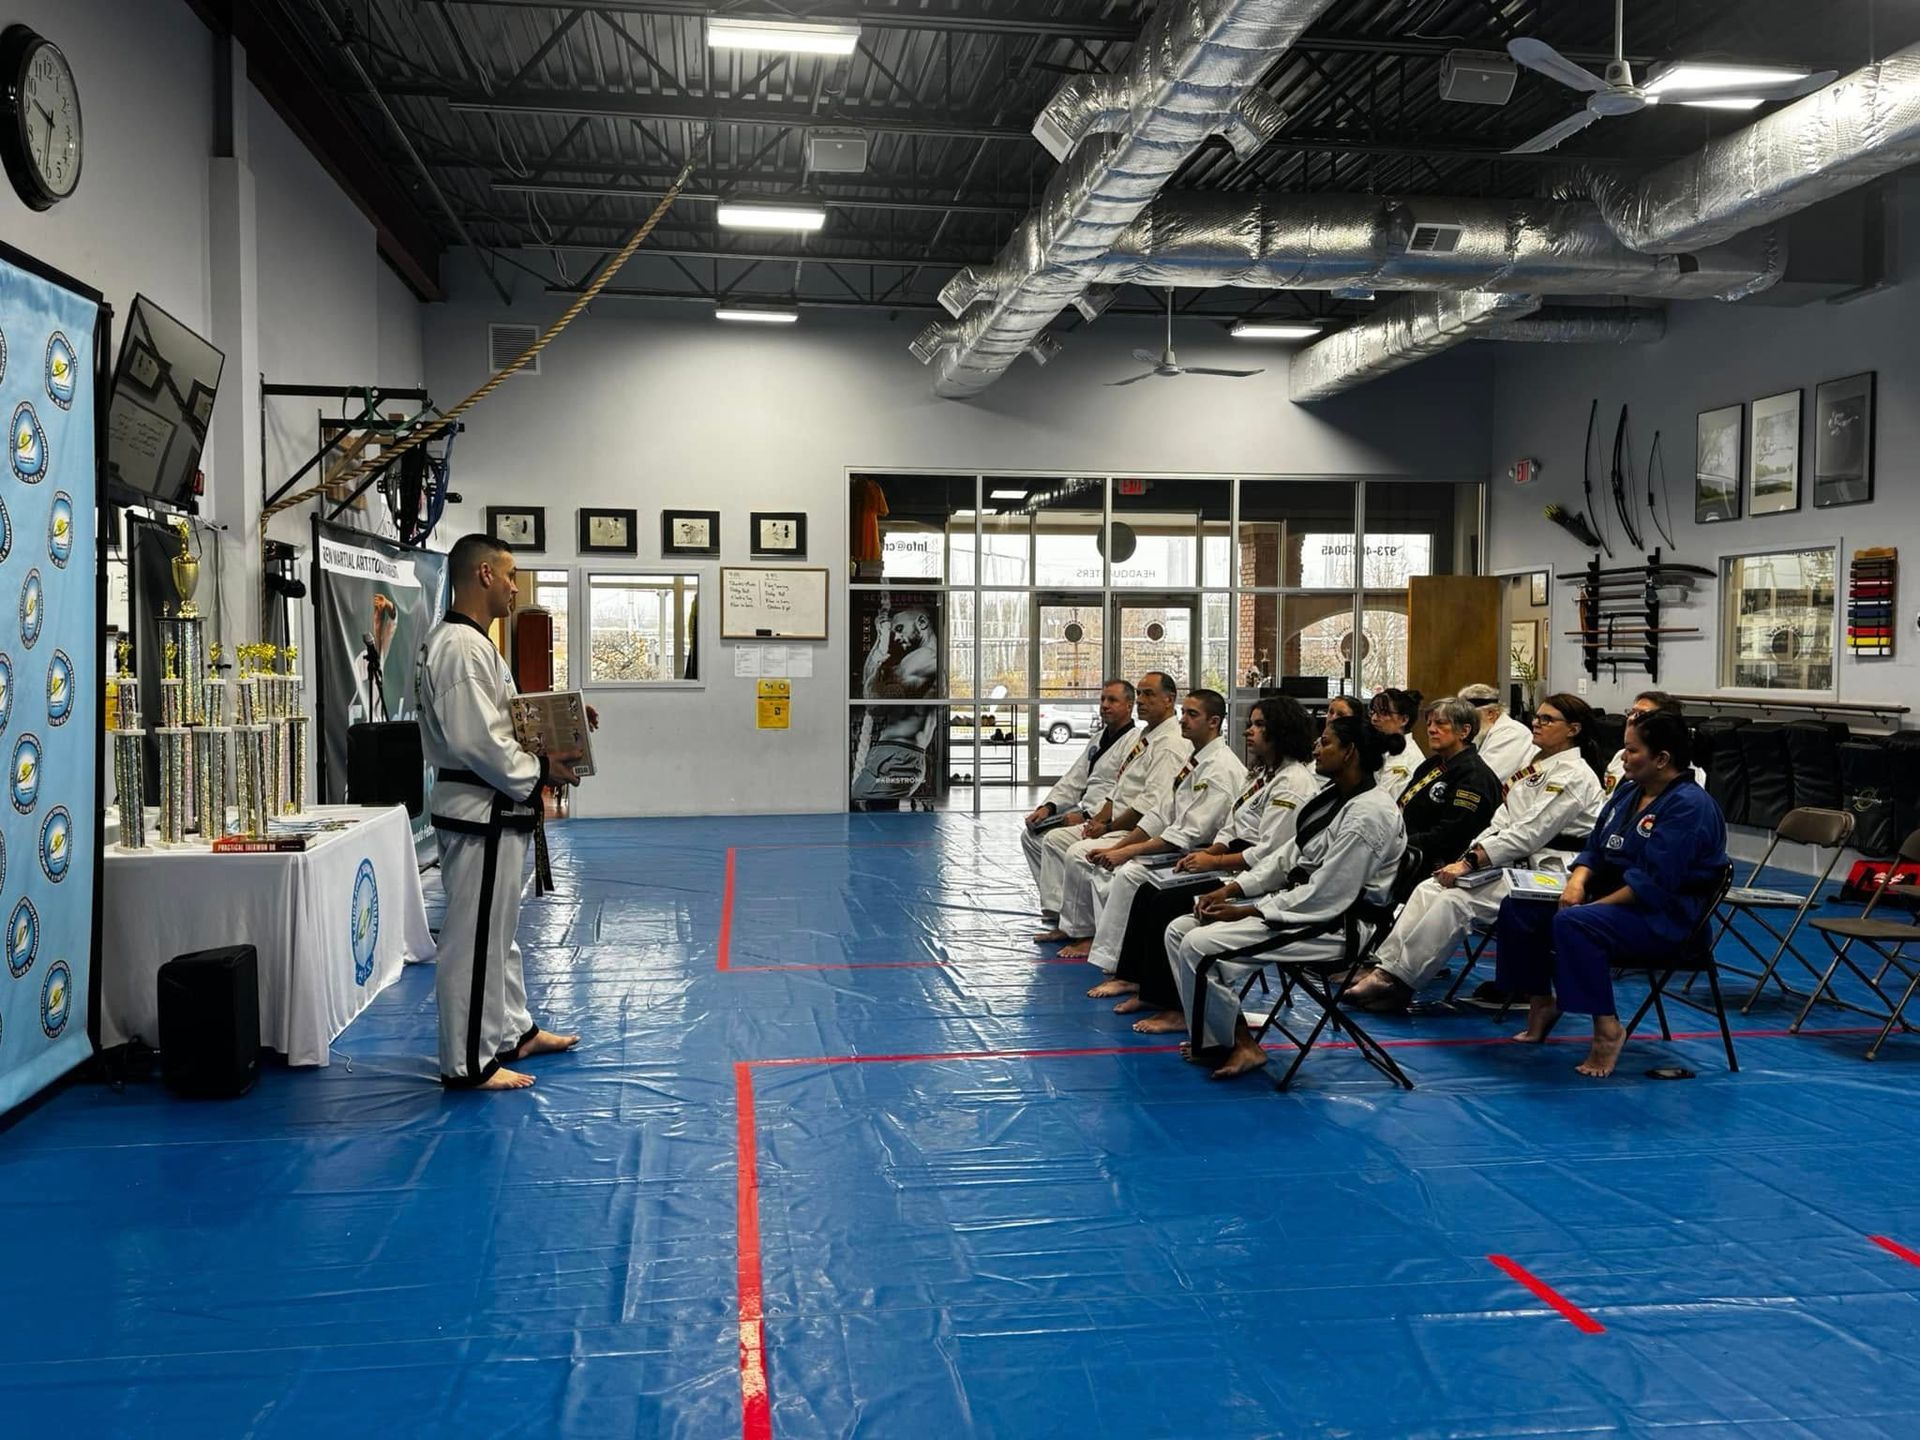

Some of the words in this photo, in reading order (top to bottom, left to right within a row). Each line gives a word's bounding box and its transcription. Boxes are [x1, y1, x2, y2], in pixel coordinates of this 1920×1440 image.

[43, 59, 53, 80] 12
[333, 549, 356, 570] MARTIAL
[217, 843, 244, 852] PRACTICAL
